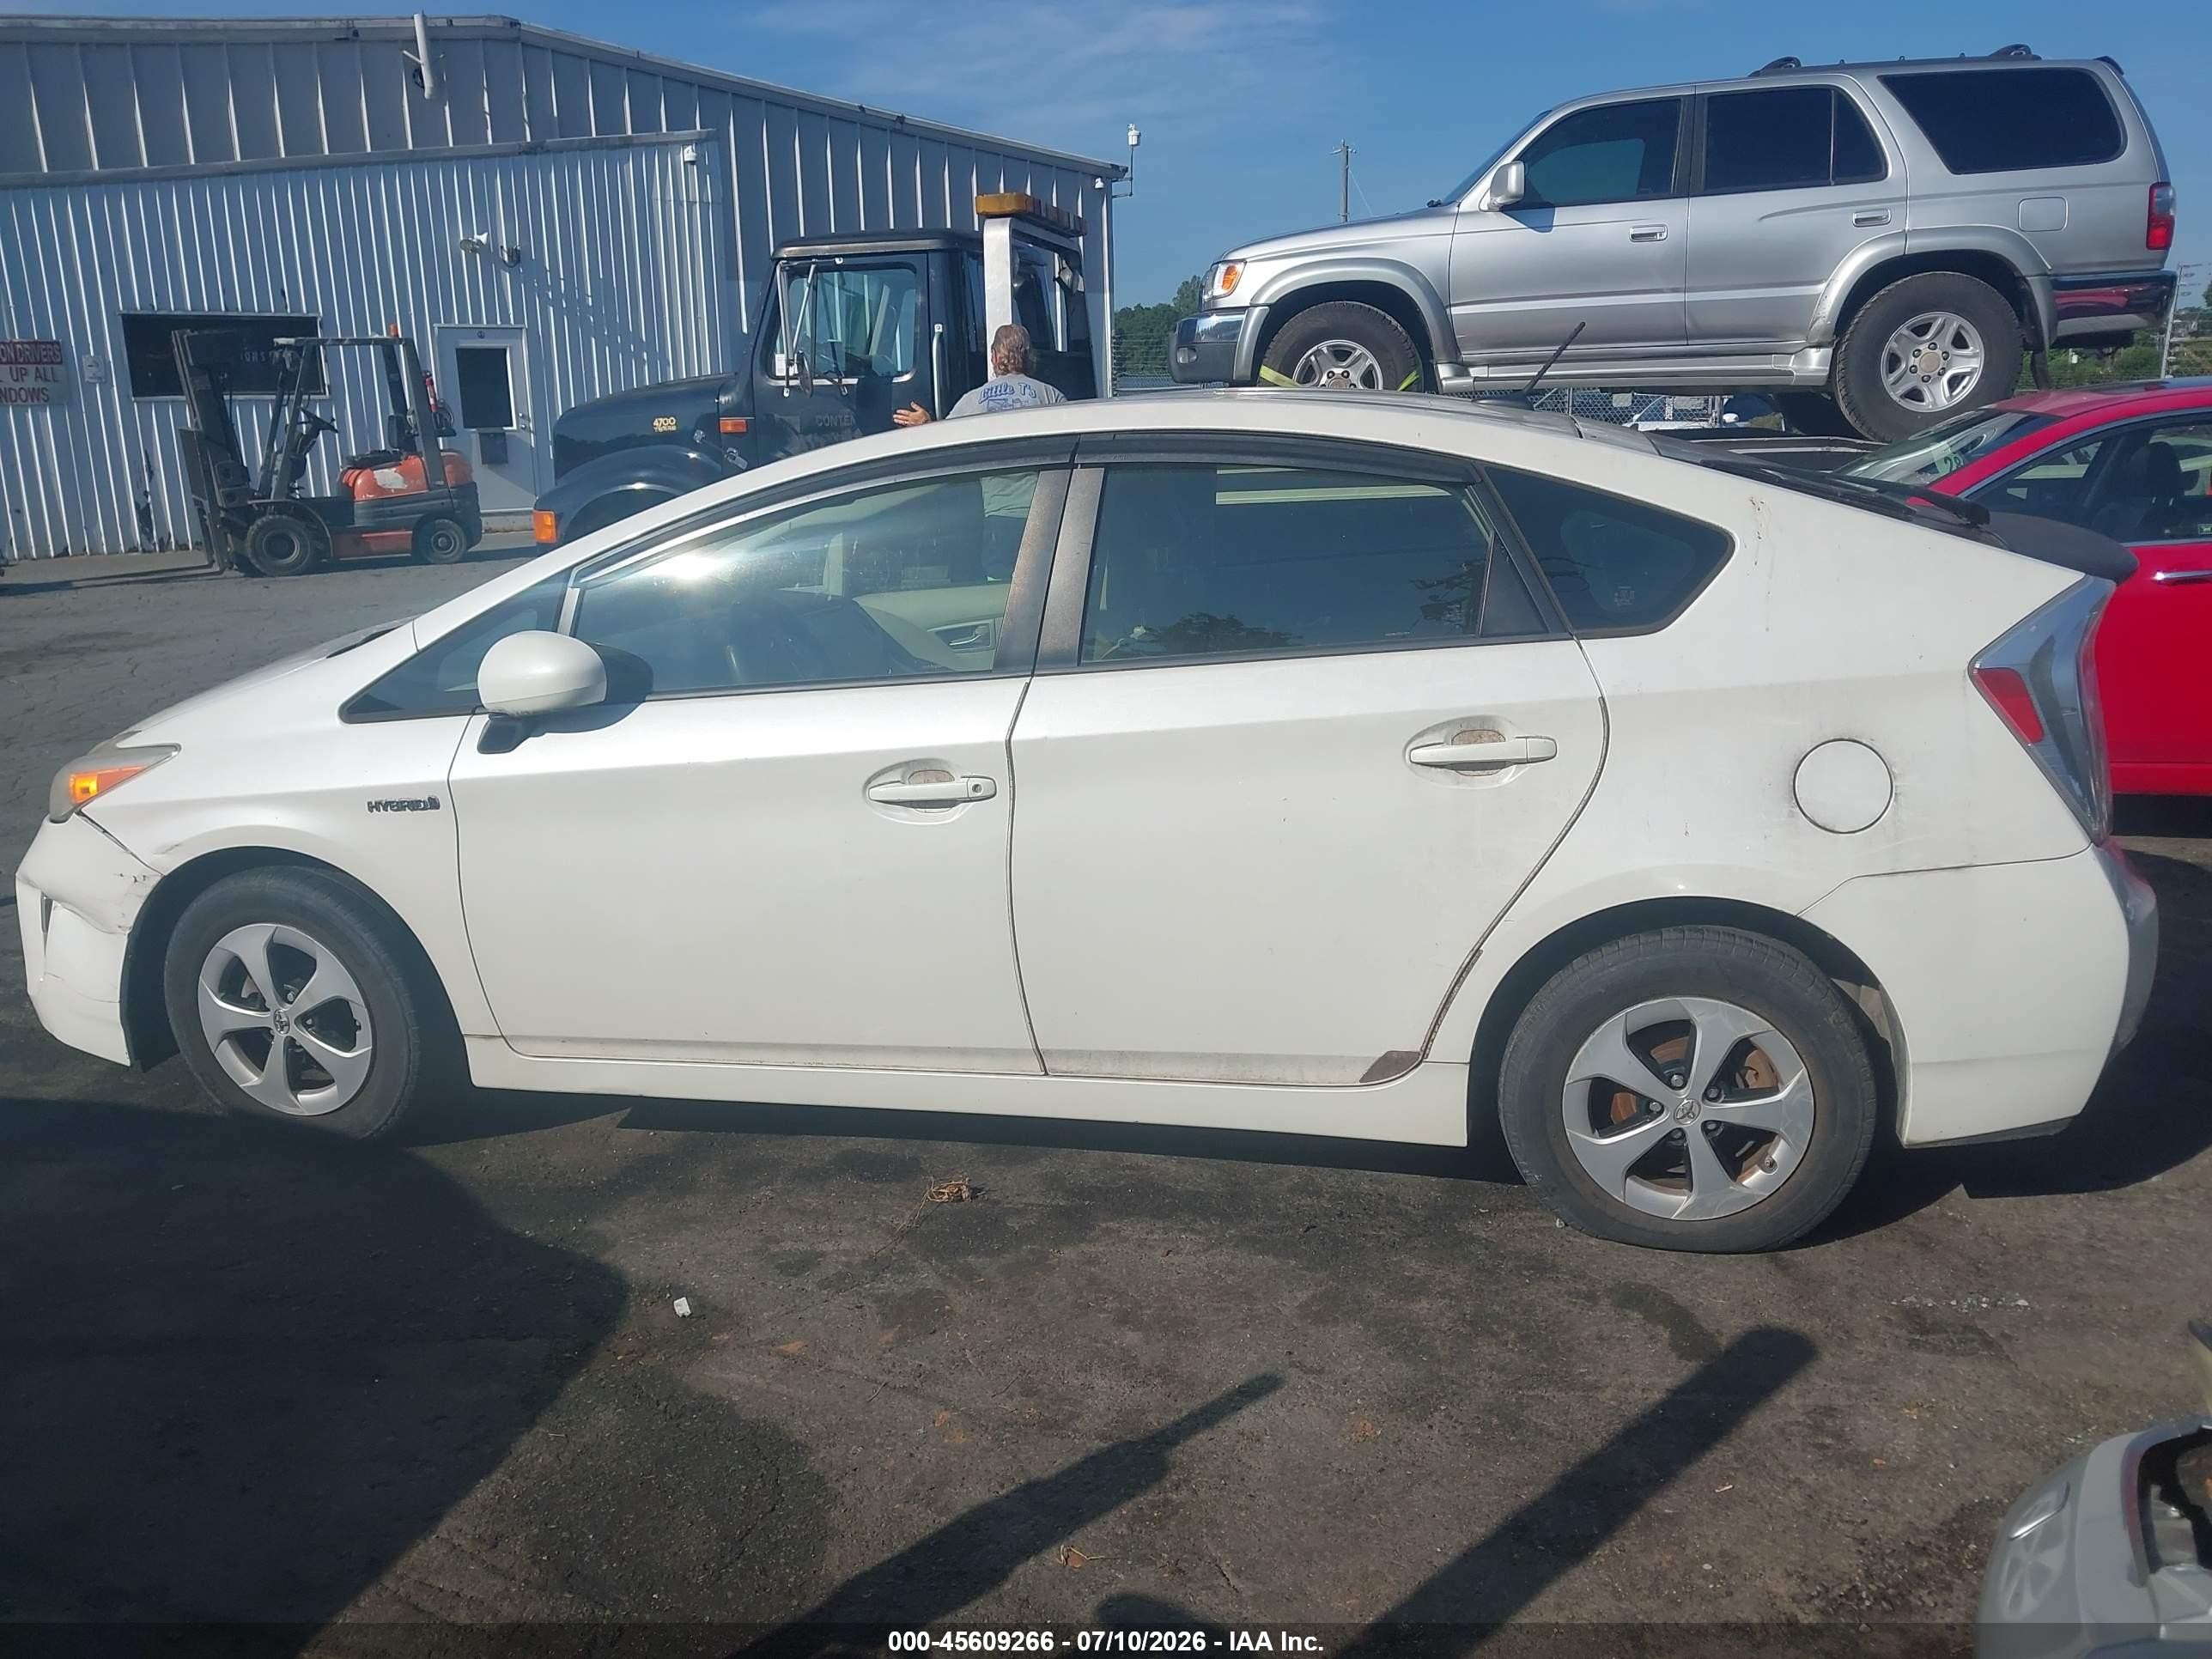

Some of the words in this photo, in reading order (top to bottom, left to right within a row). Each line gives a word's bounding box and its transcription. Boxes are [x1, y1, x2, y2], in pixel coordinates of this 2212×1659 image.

[15, 343, 61, 362] DRIVERS
[9, 366, 28, 383] UP
[34, 366, 59, 383] ALL
[978, 382, 1015, 404] Little
[1018, 382, 1037, 399] T's
[653, 416, 677, 428] 4700
[367, 798, 428, 813] HYBRID
